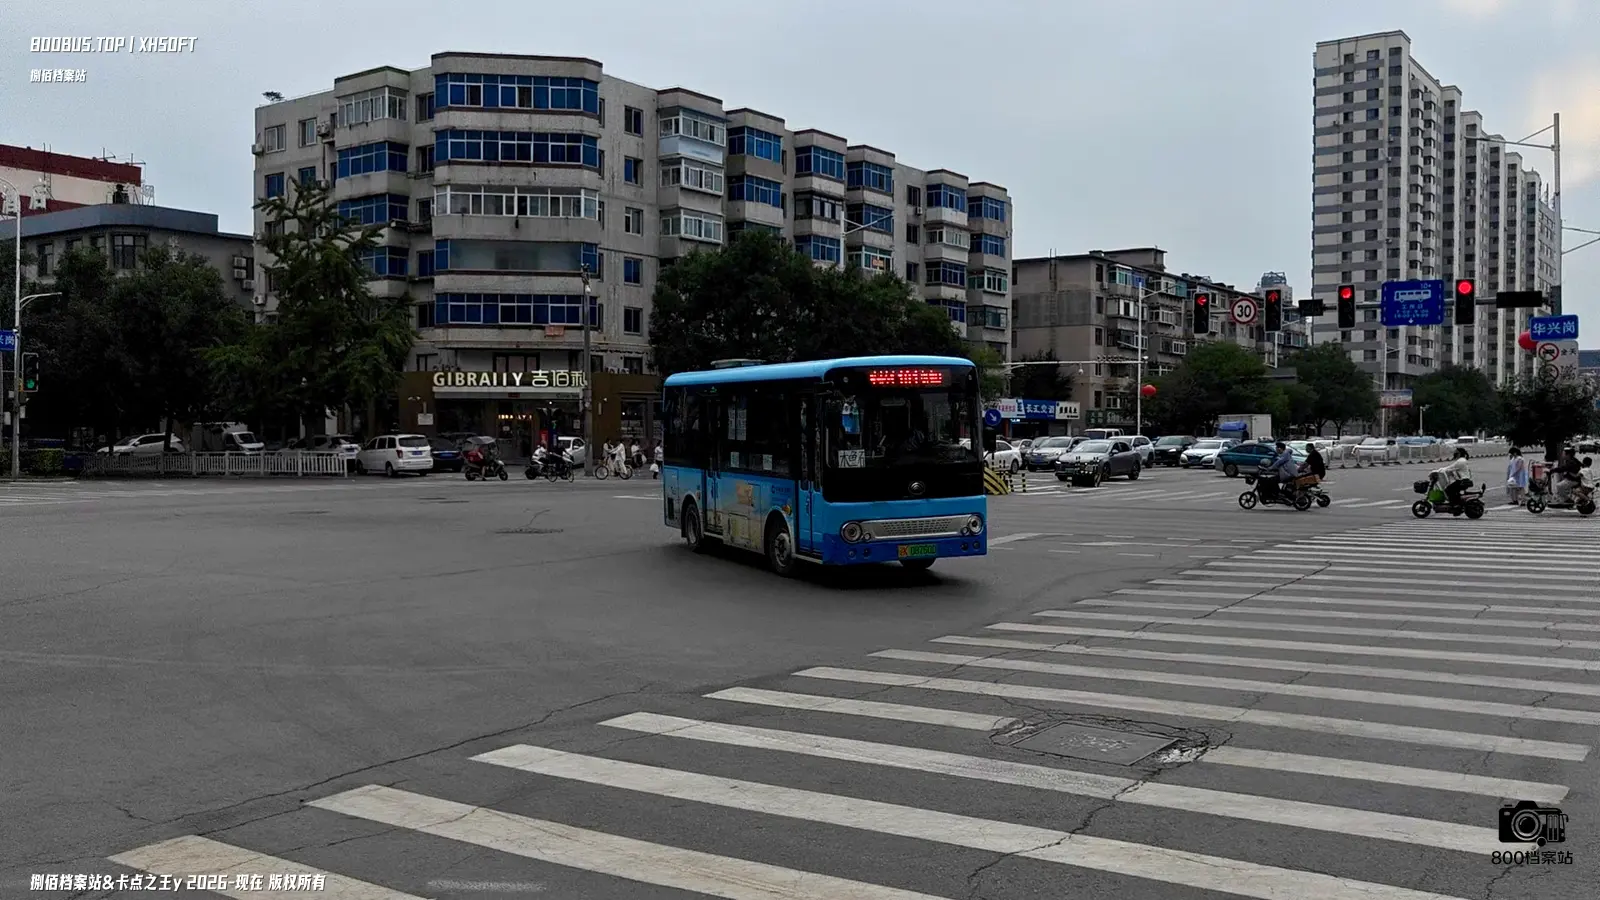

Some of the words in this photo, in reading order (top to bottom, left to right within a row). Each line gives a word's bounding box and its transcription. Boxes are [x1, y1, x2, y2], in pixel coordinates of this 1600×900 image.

[1237, 304, 1252, 318] 30
[1532, 321, 1576, 336] 华兴岗
